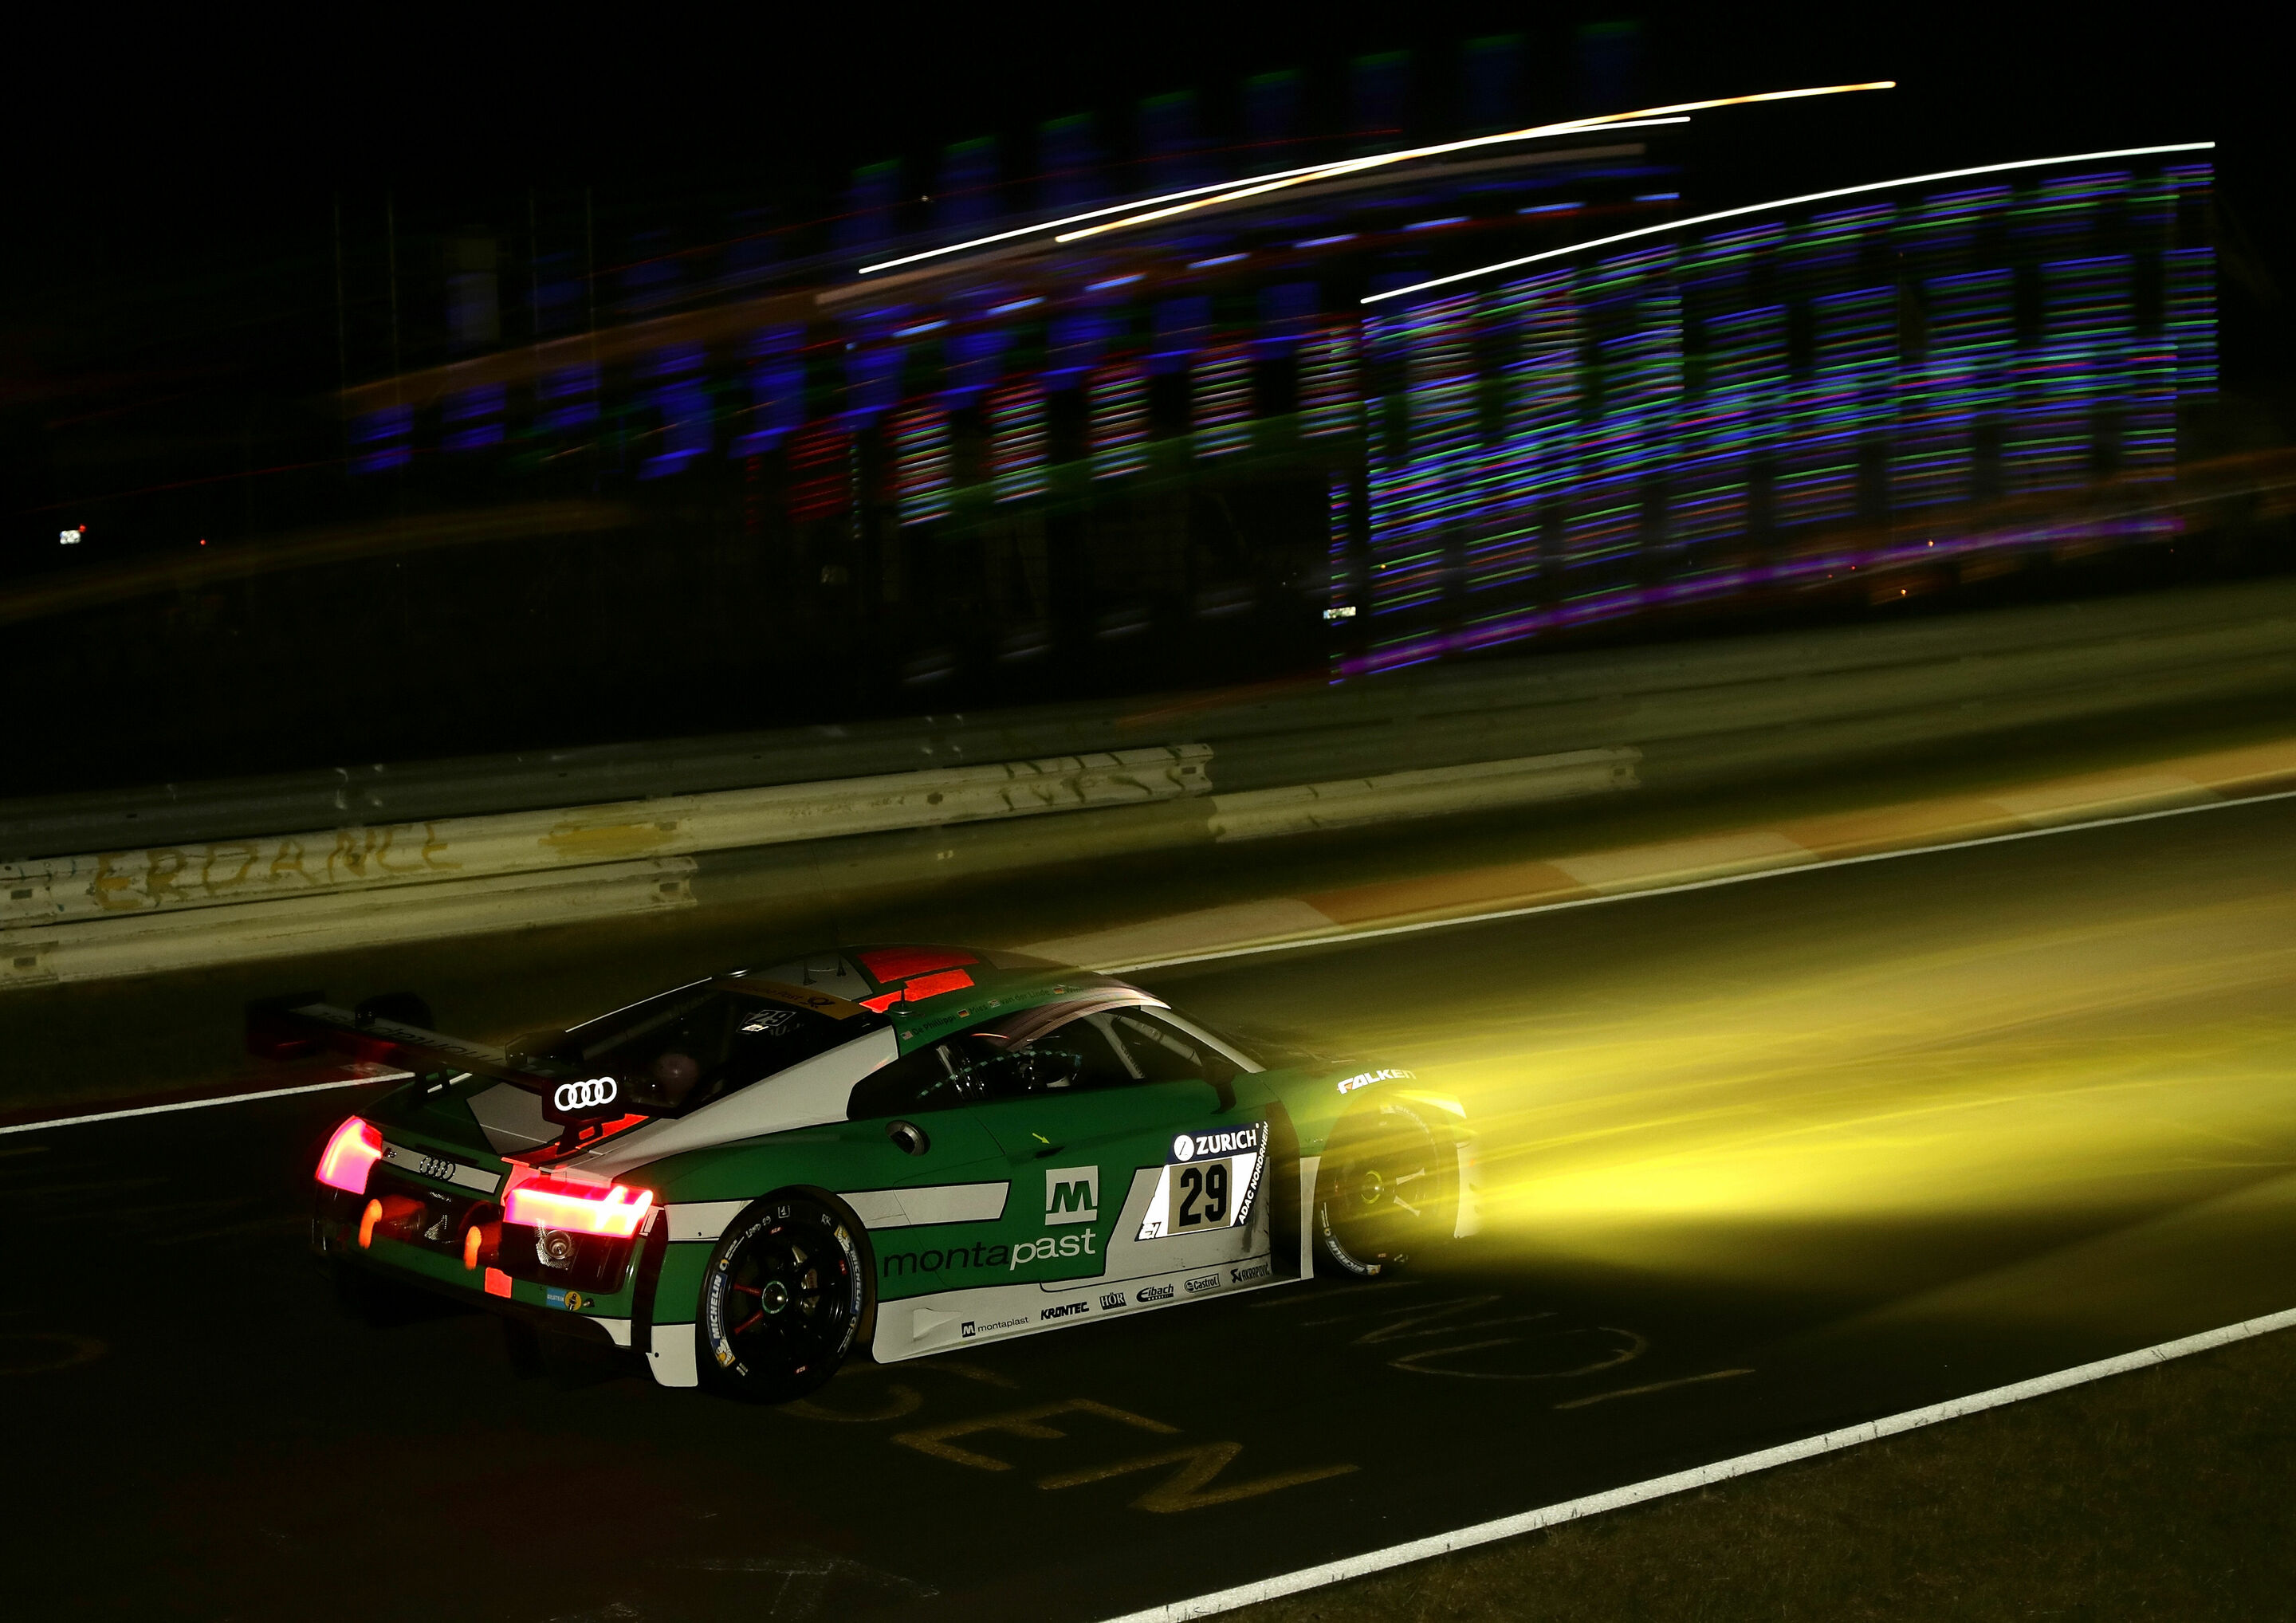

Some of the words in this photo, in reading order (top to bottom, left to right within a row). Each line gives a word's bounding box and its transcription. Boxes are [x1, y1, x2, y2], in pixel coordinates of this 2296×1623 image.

[1196, 1129, 1256, 1155] ZURICH
[1238, 1190, 1254, 1224] ADAC
[1250, 1122, 1269, 1189] NORDRHEIN
[1179, 1164, 1227, 1227] 29
[883, 1228, 1096, 1277] montapast
[1136, 1283, 1174, 1303] Eibach
[1193, 1277, 1218, 1291] Castrol
[710, 1275, 721, 1339] MICHELIN
[1040, 1302, 1090, 1320] KRONTEC
[1100, 1292, 1126, 1307] HÖR
[977, 1317, 1029, 1333] montaplast
